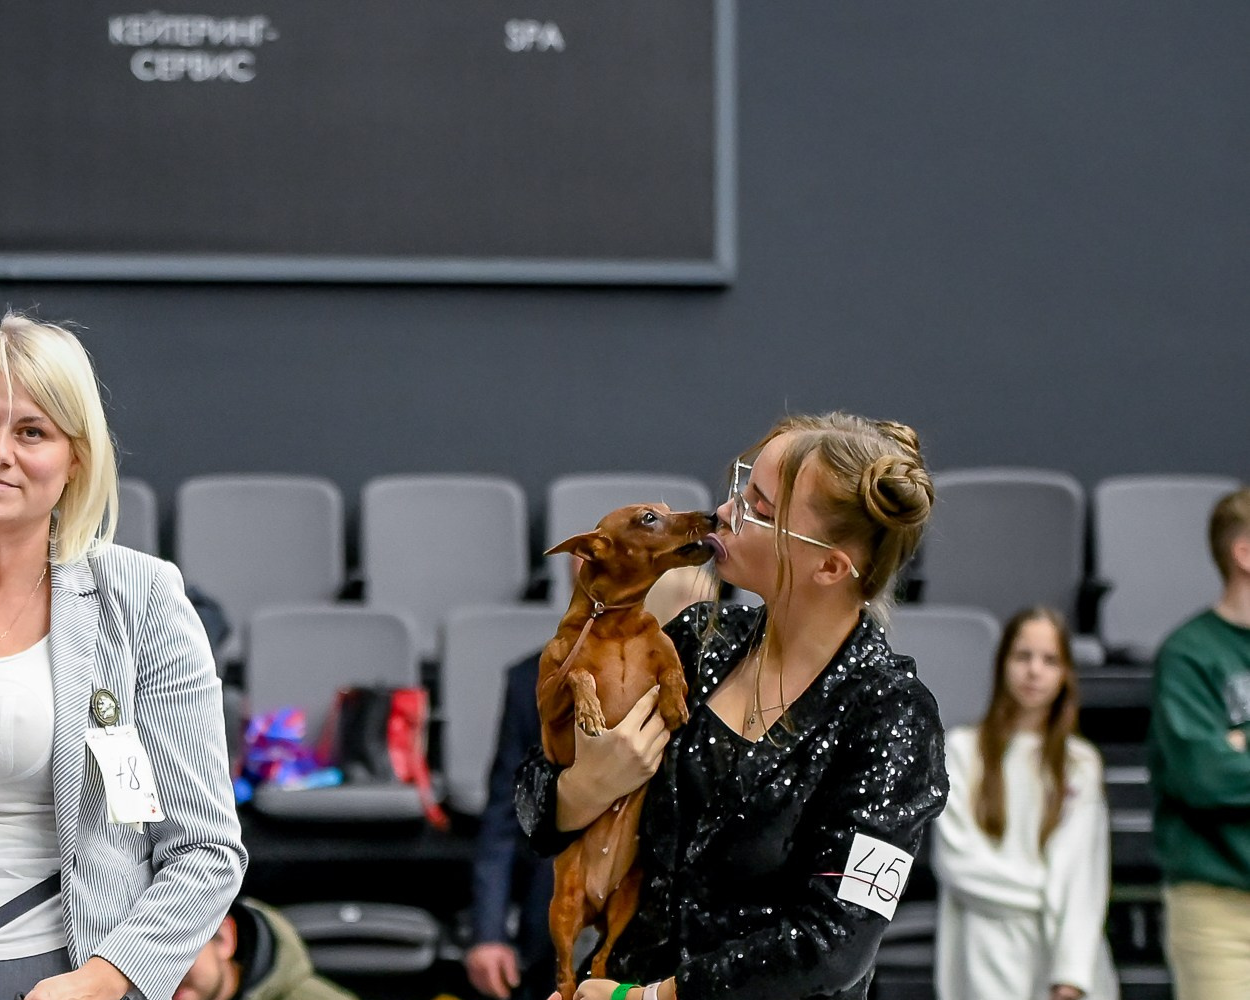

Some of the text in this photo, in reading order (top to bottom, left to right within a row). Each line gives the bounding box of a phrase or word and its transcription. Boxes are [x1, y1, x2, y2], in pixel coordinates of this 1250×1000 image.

[504, 18, 566, 53] SPA
[130, 50, 257, 83] СЕРВИС
[853, 847, 906, 902] 45
